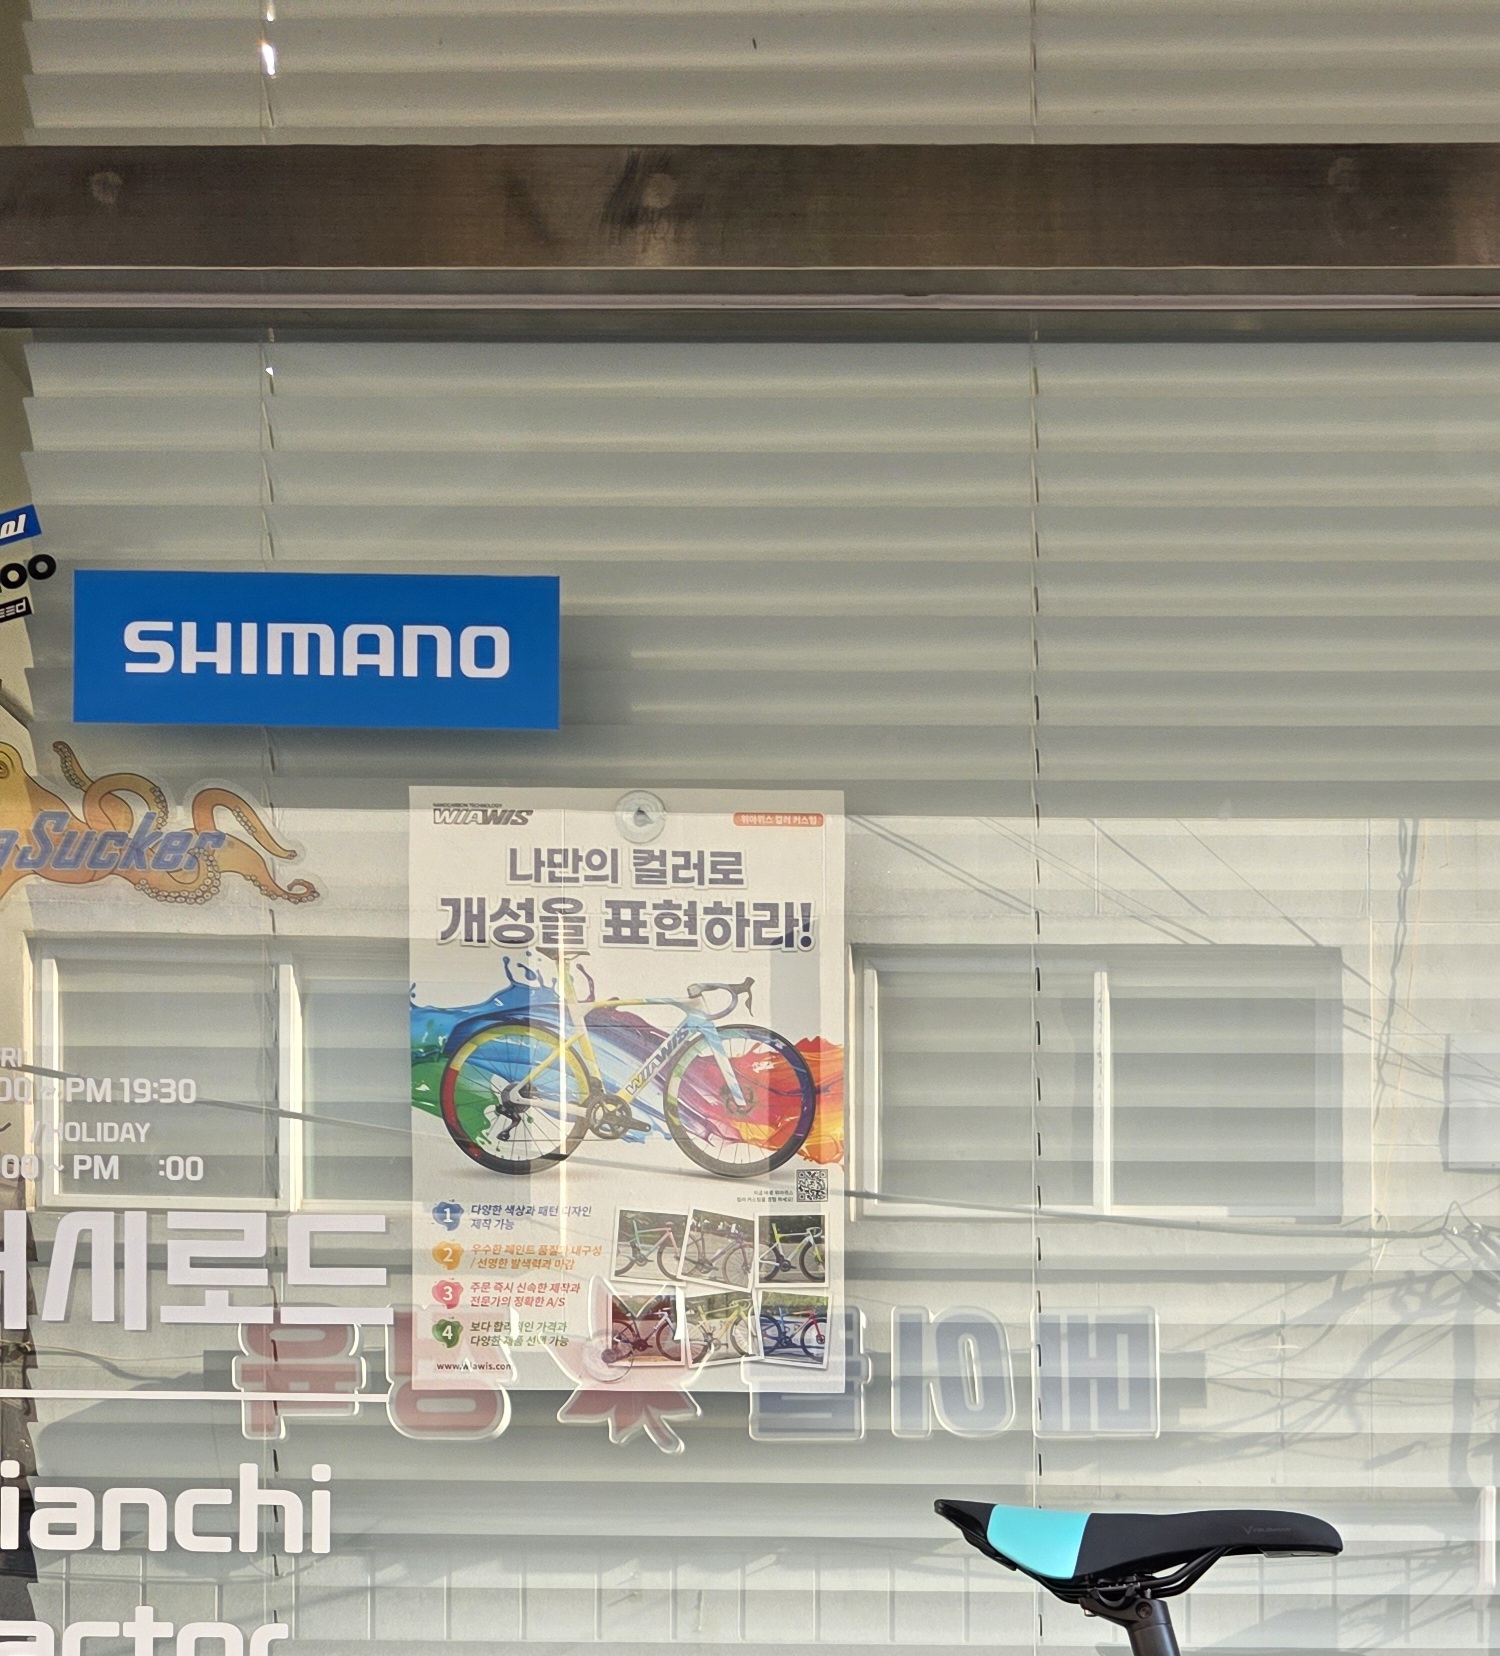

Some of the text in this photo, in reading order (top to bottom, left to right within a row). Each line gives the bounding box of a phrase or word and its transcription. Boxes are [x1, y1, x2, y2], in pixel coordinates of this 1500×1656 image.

[124, 621, 510, 678] SHIMANO
[433, 809, 533, 825] WIAWIS
[510, 848, 744, 885] 나만의 컬러로
[441, 897, 811, 948] 개성을 표현하라!
[625, 1027, 690, 1095] WIAWIS
[66, 1078, 112, 1102] PM
[120, 1078, 196, 1103] 19:30
[74, 1155, 119, 1179] PM
[442, 1208, 453, 1222] 1
[471, 1204, 503, 1217] 다양한
[504, 1204, 537, 1217] 색상과
[471, 1218, 515, 1231] 제작 가능
[443, 1247, 453, 1262] 2
[472, 1243, 503, 1257] 우수한
[571, 1244, 603, 1257] 내구성
[443, 1286, 453, 1300] 3
[470, 1282, 581, 1294] 주문 즉시 신속한 제작과
[470, 1295, 566, 1308] 전문가의 정확한 A/S
[442, 1325, 453, 1340] 4
[470, 1321, 492, 1333] 보다
